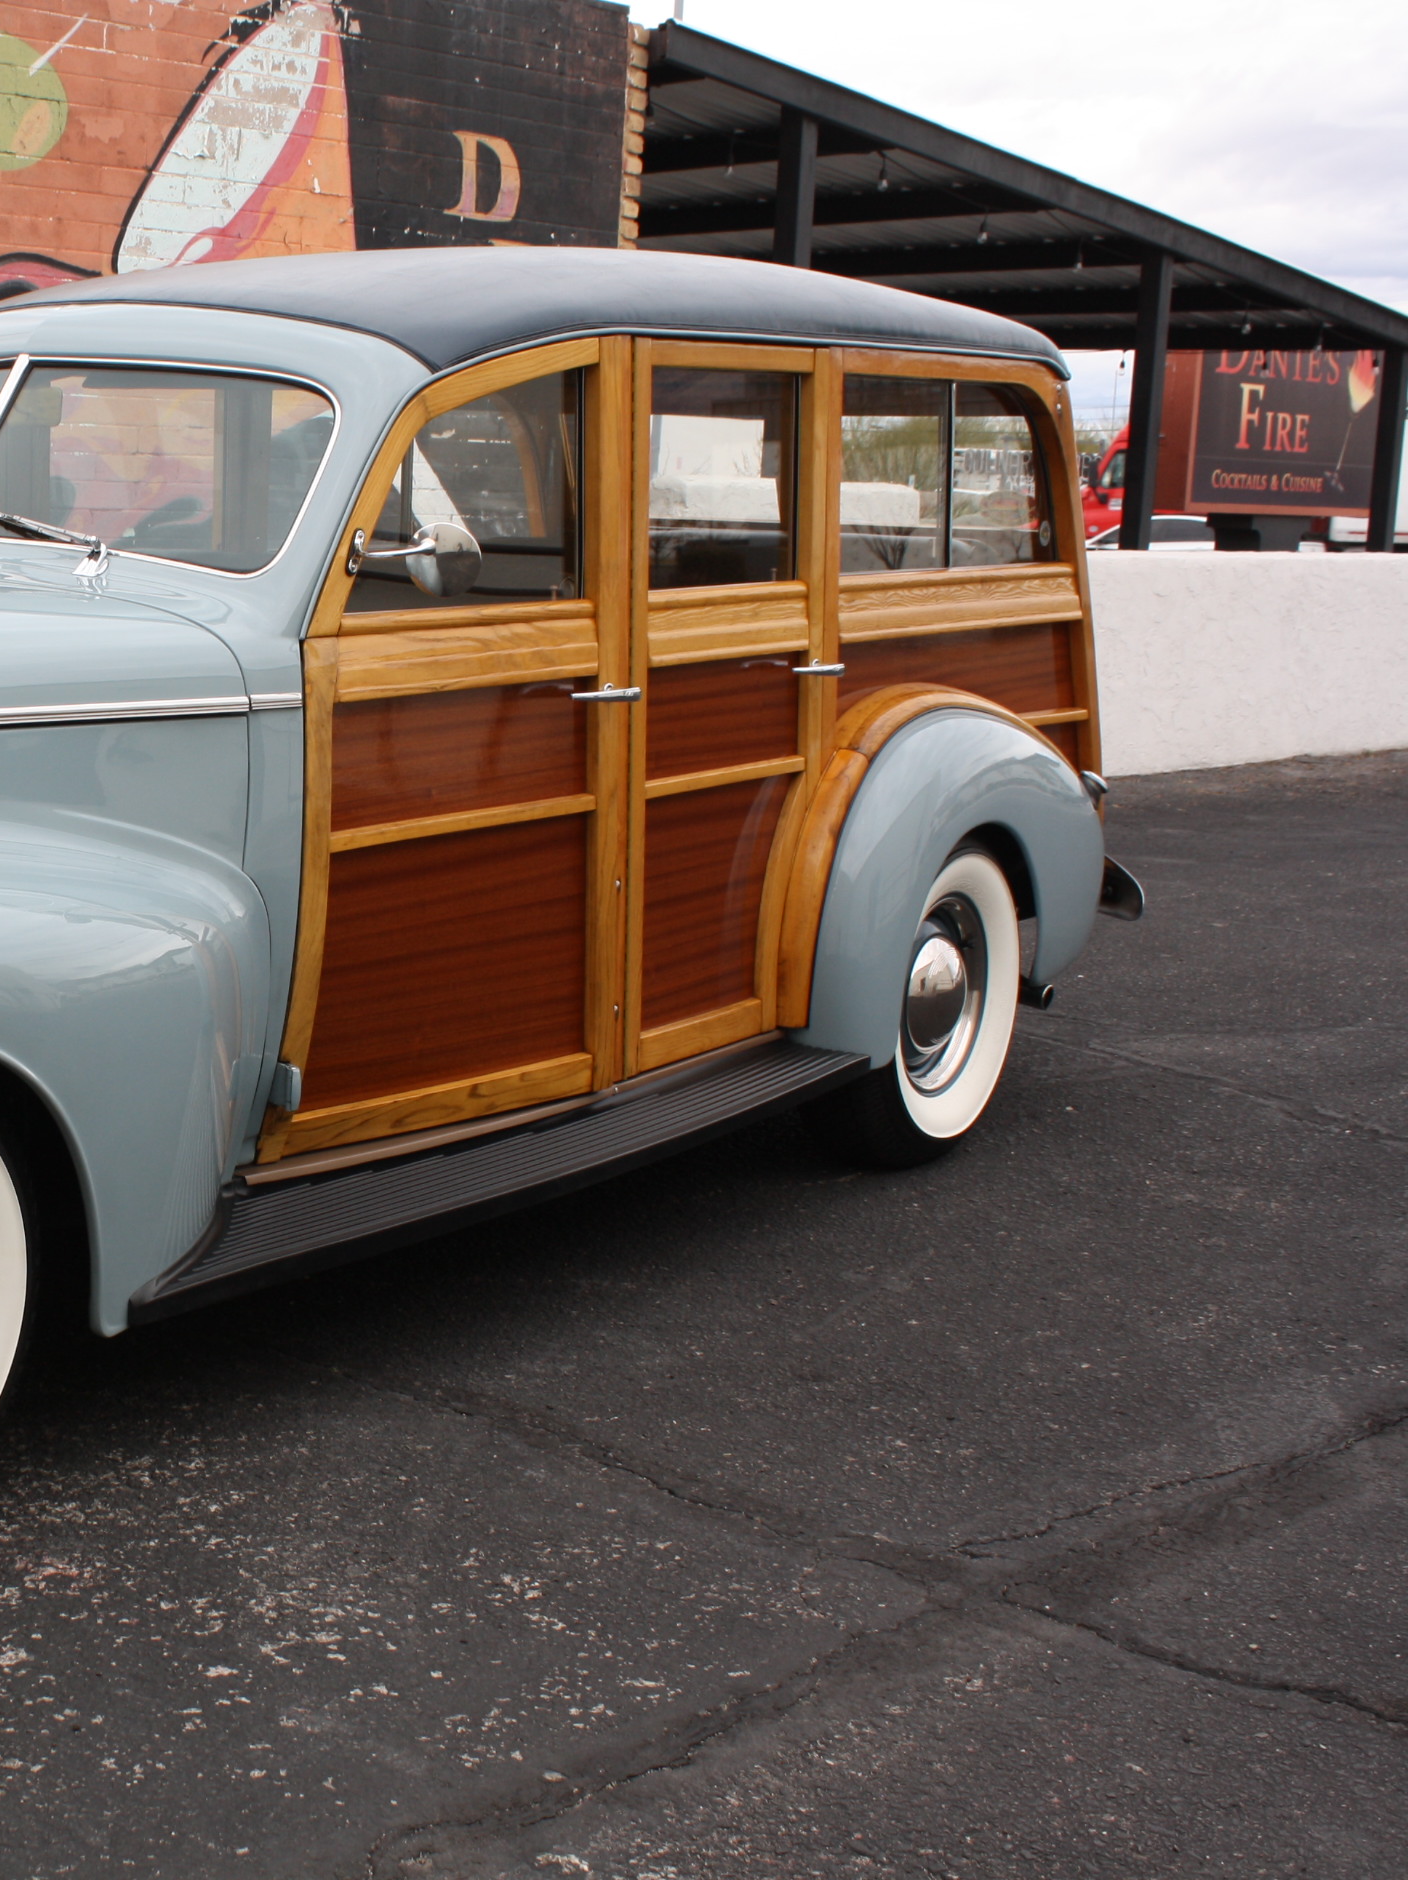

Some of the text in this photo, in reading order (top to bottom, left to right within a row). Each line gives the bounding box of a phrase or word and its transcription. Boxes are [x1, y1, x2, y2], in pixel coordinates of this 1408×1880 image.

[443, 130, 521, 223] D
[1234, 382, 1311, 454] FIRE
[1270, 474, 1280, 491] &
